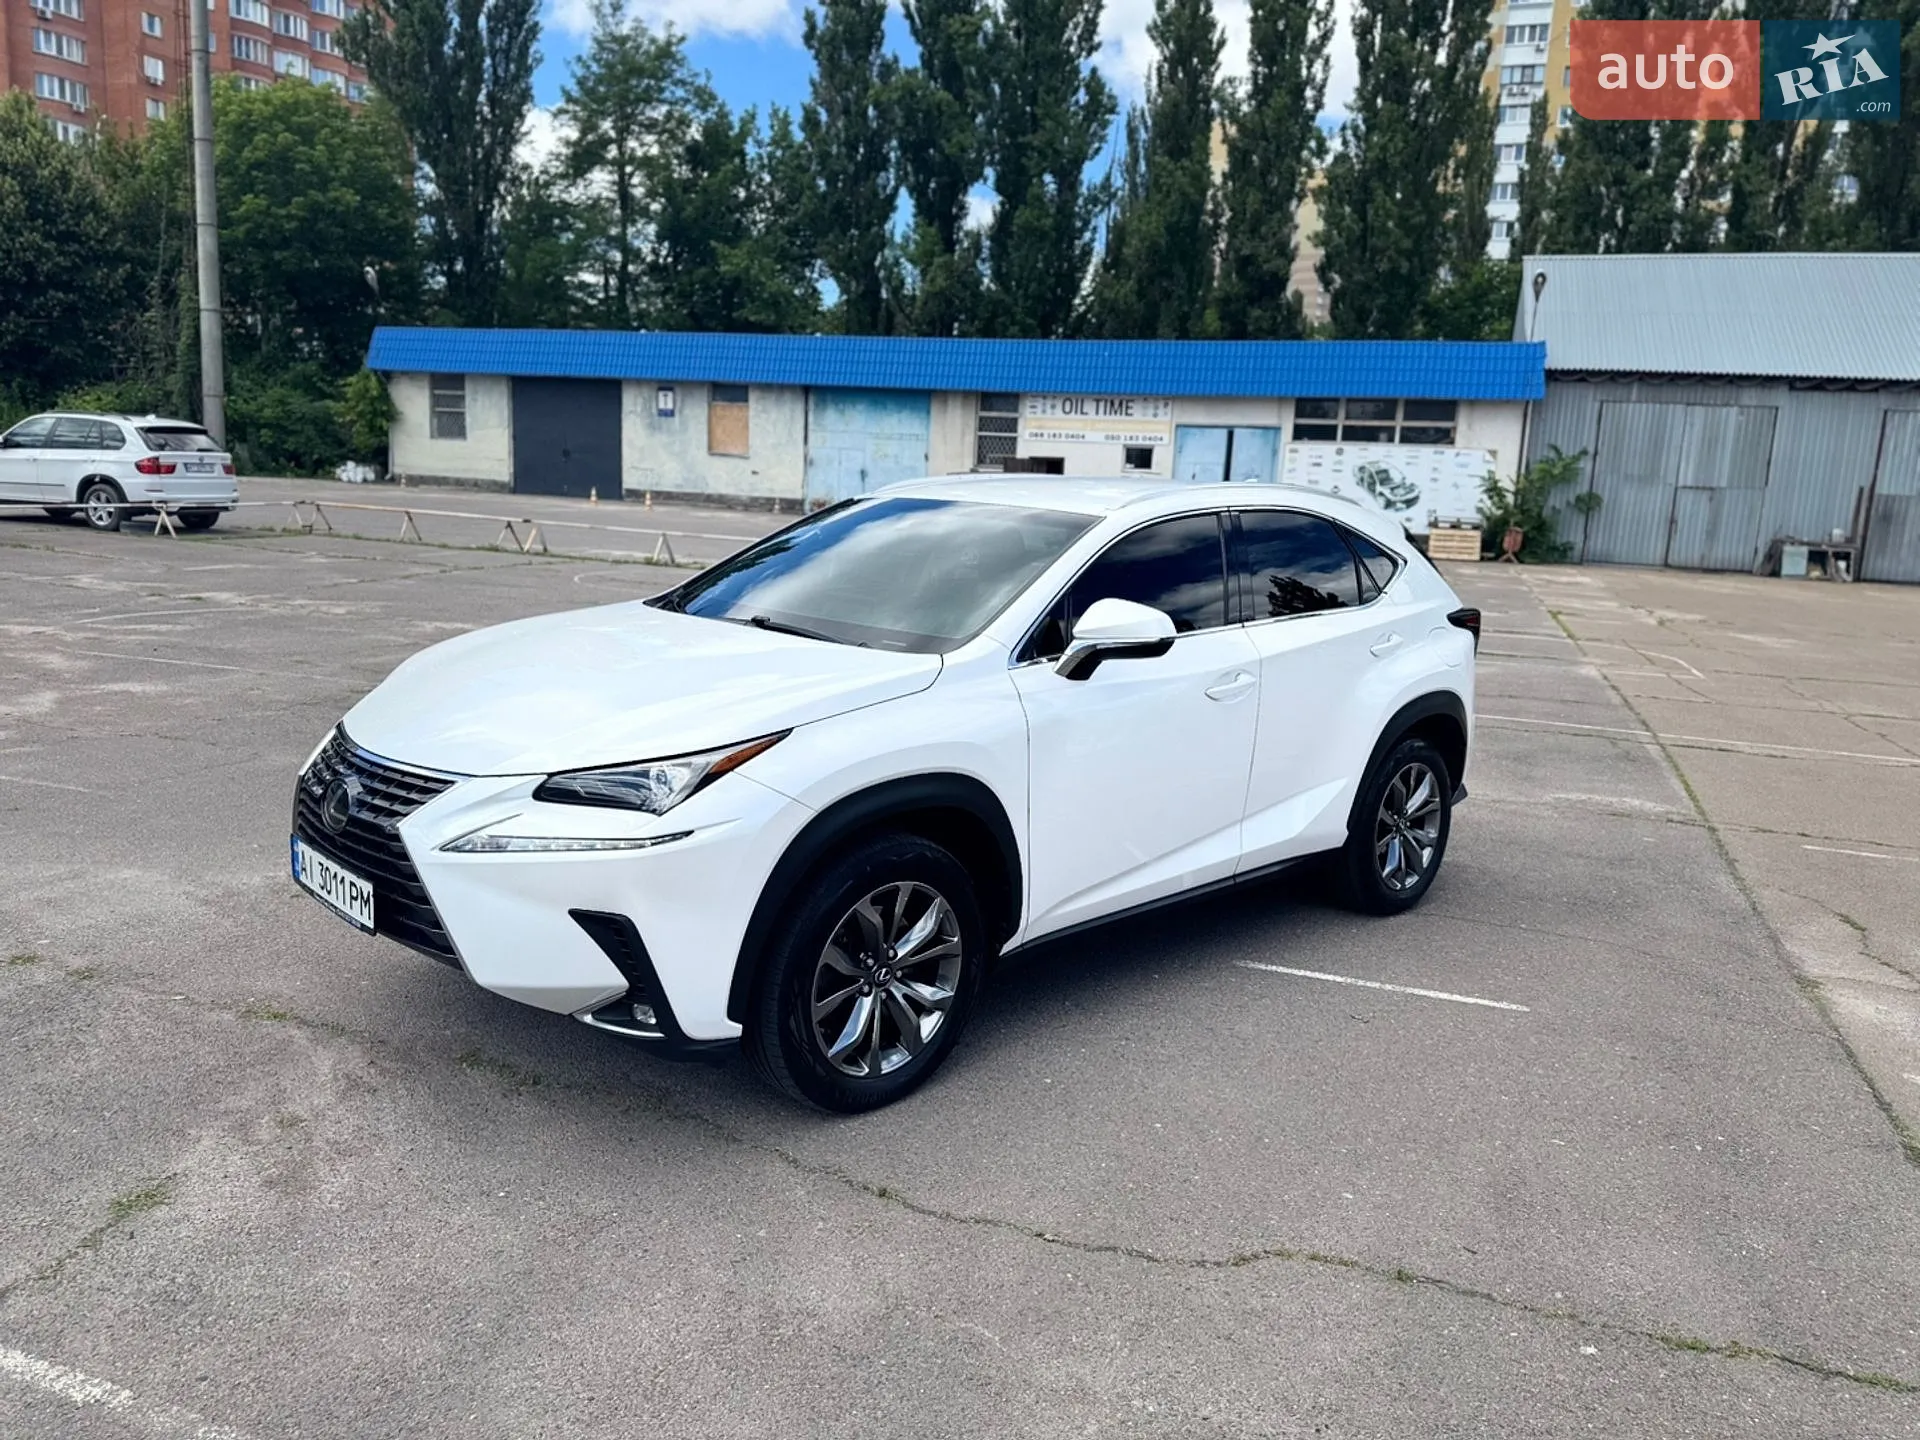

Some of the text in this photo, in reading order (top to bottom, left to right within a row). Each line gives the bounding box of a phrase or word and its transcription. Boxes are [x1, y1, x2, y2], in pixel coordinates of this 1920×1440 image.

[1061, 397, 1135, 417] OIL TIME
[301, 850, 314, 883] AI
[318, 861, 347, 906] 3011
[349, 880, 371, 921] PM
